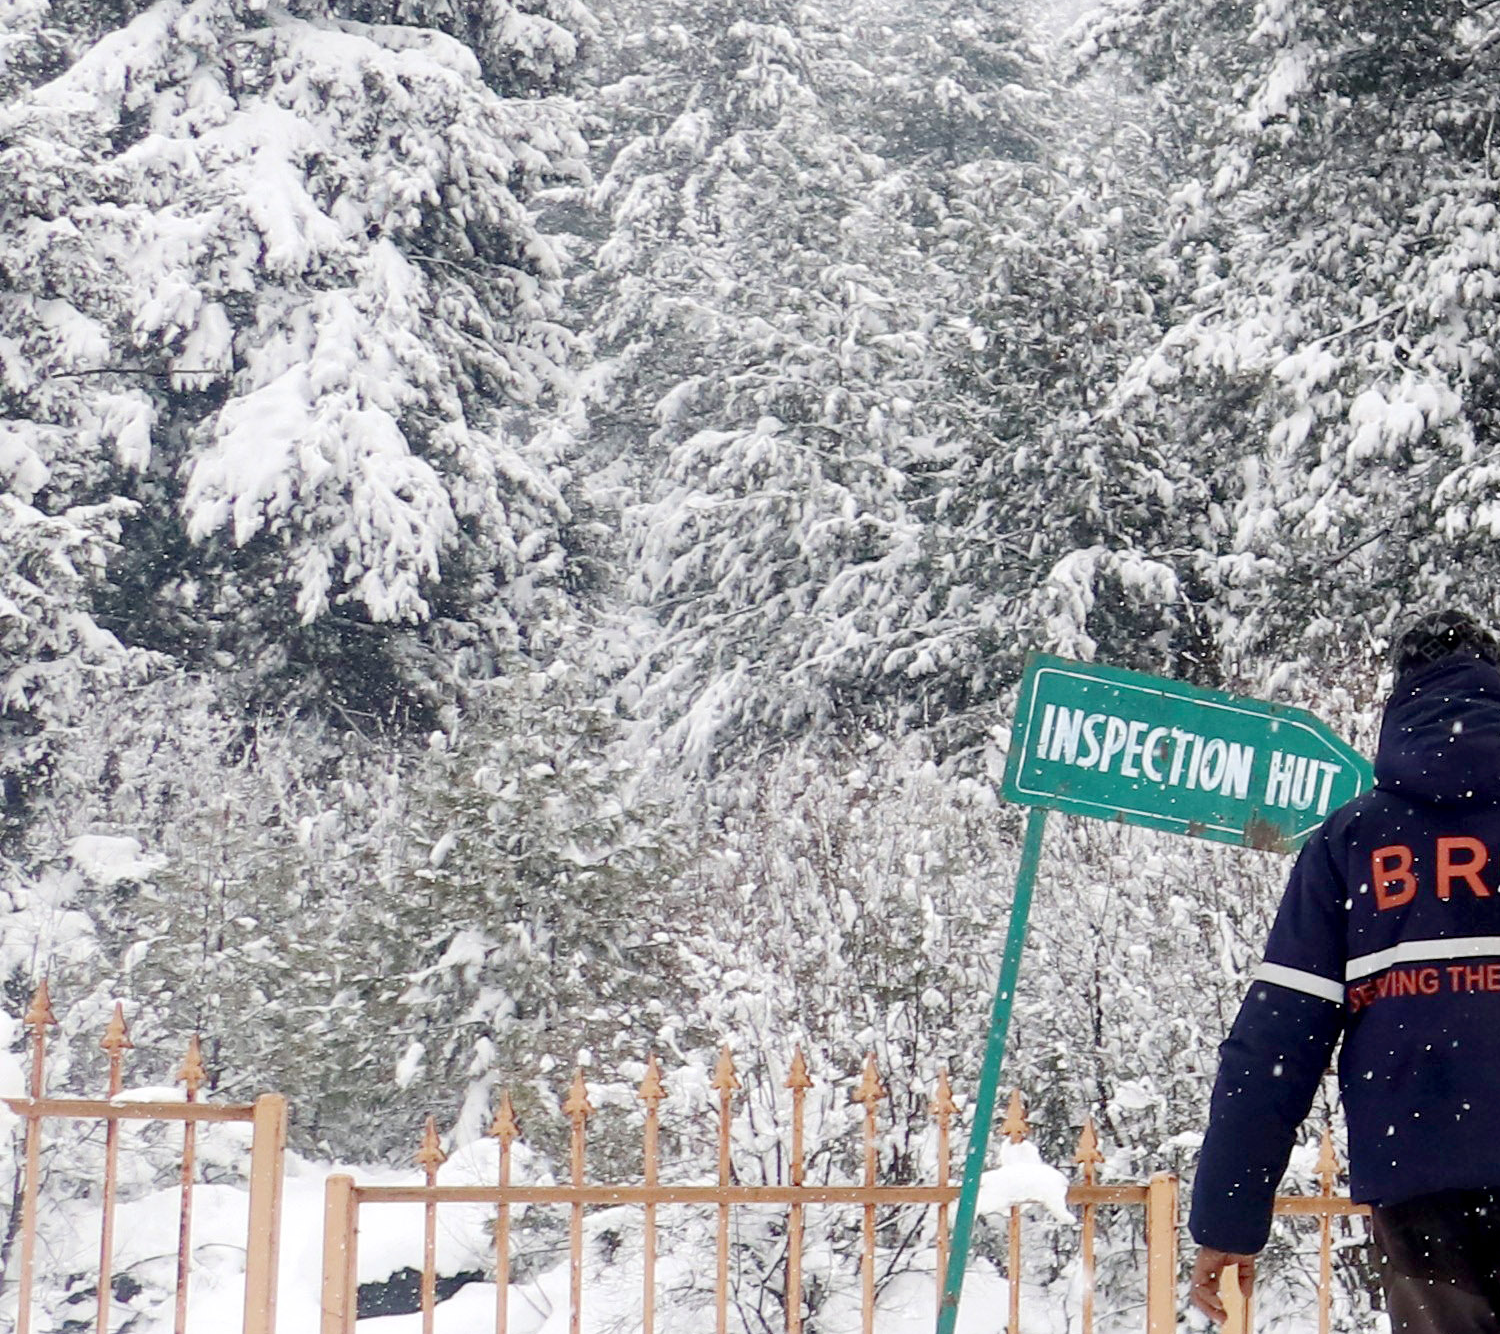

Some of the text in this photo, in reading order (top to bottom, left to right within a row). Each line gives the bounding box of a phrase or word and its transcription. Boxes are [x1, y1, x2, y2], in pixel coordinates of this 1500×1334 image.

[1036, 703, 1343, 817] INSPECTION HUT
[1350, 967, 1440, 1013] SEVING
